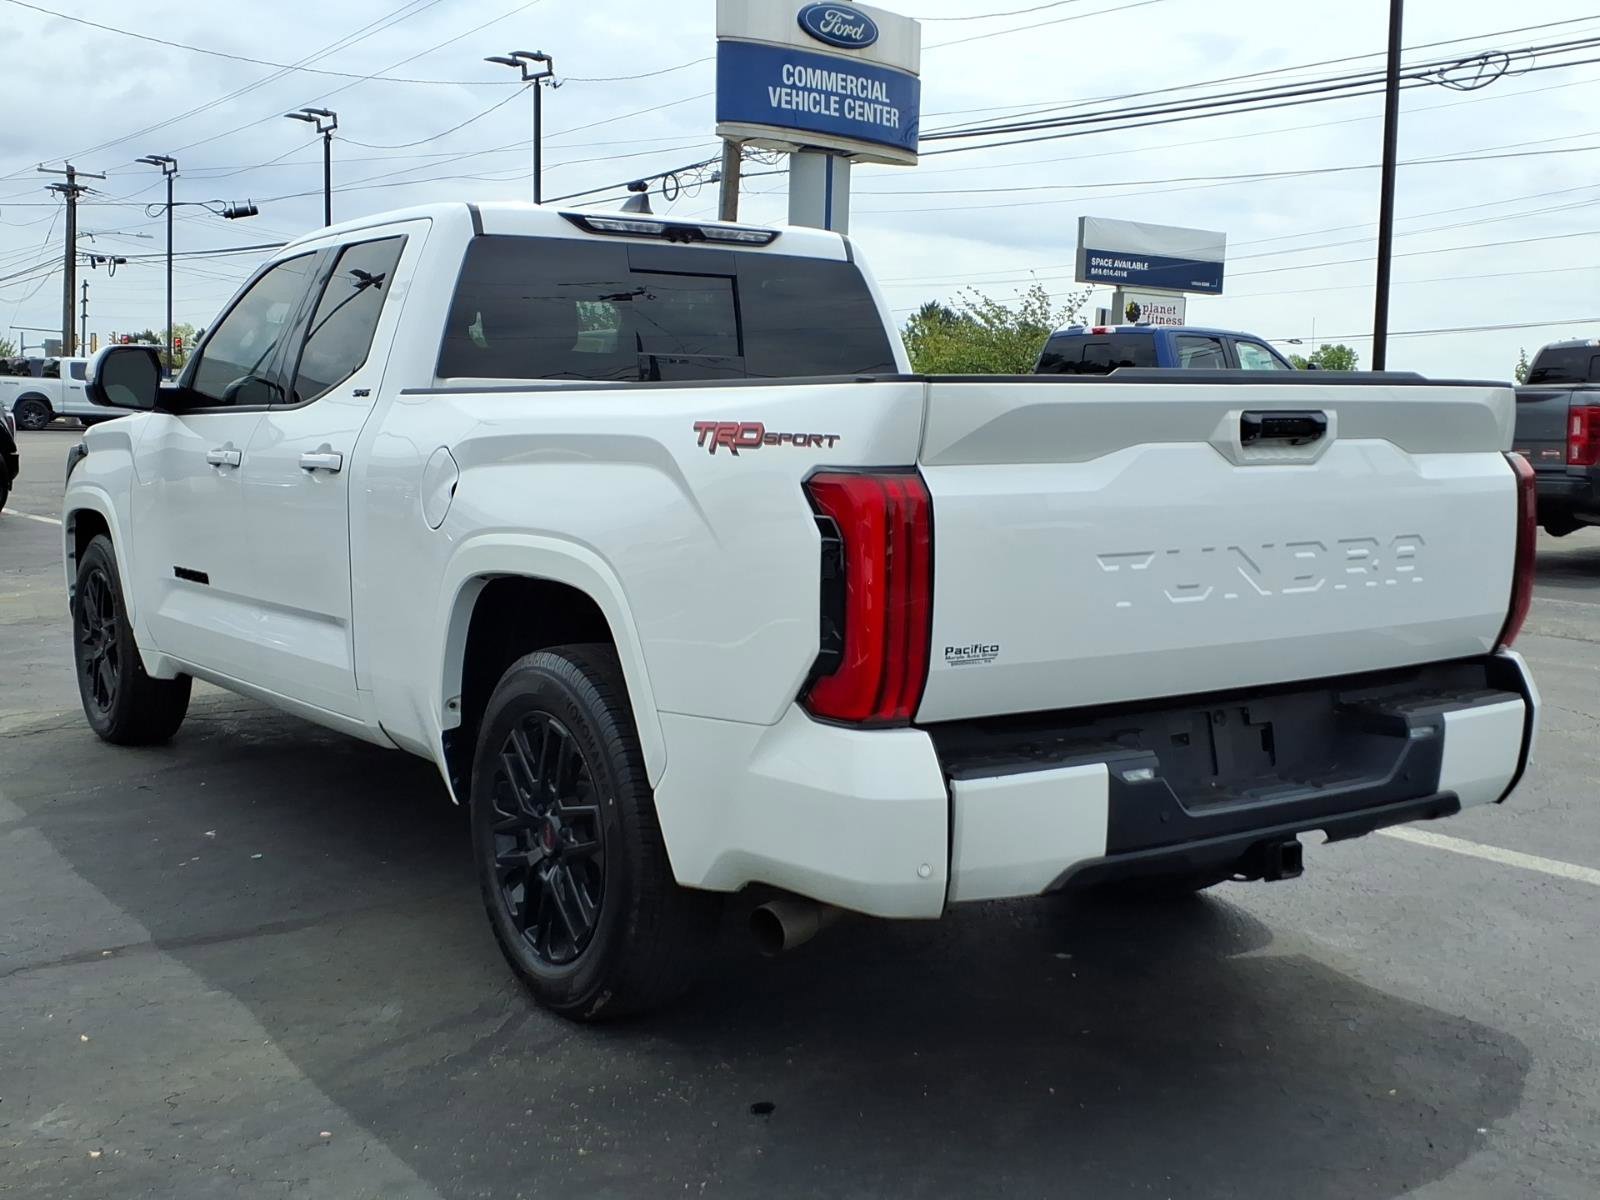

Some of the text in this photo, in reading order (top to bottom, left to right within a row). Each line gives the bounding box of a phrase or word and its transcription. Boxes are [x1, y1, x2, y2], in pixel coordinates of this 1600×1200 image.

[820, 9, 865, 41] Ford
[782, 63, 890, 103] COMMERCIAL
[768, 86, 899, 129] VEHICLE CENTER
[1091, 257, 1149, 271] SPACE AVAILABLE
[1142, 302, 1176, 316] planet
[1147, 313, 1183, 326] fitness
[693, 421, 840, 456] TRD SPORT
[1097, 534, 1426, 607] TUNDRA
[945, 643, 999, 656] Pacifico
